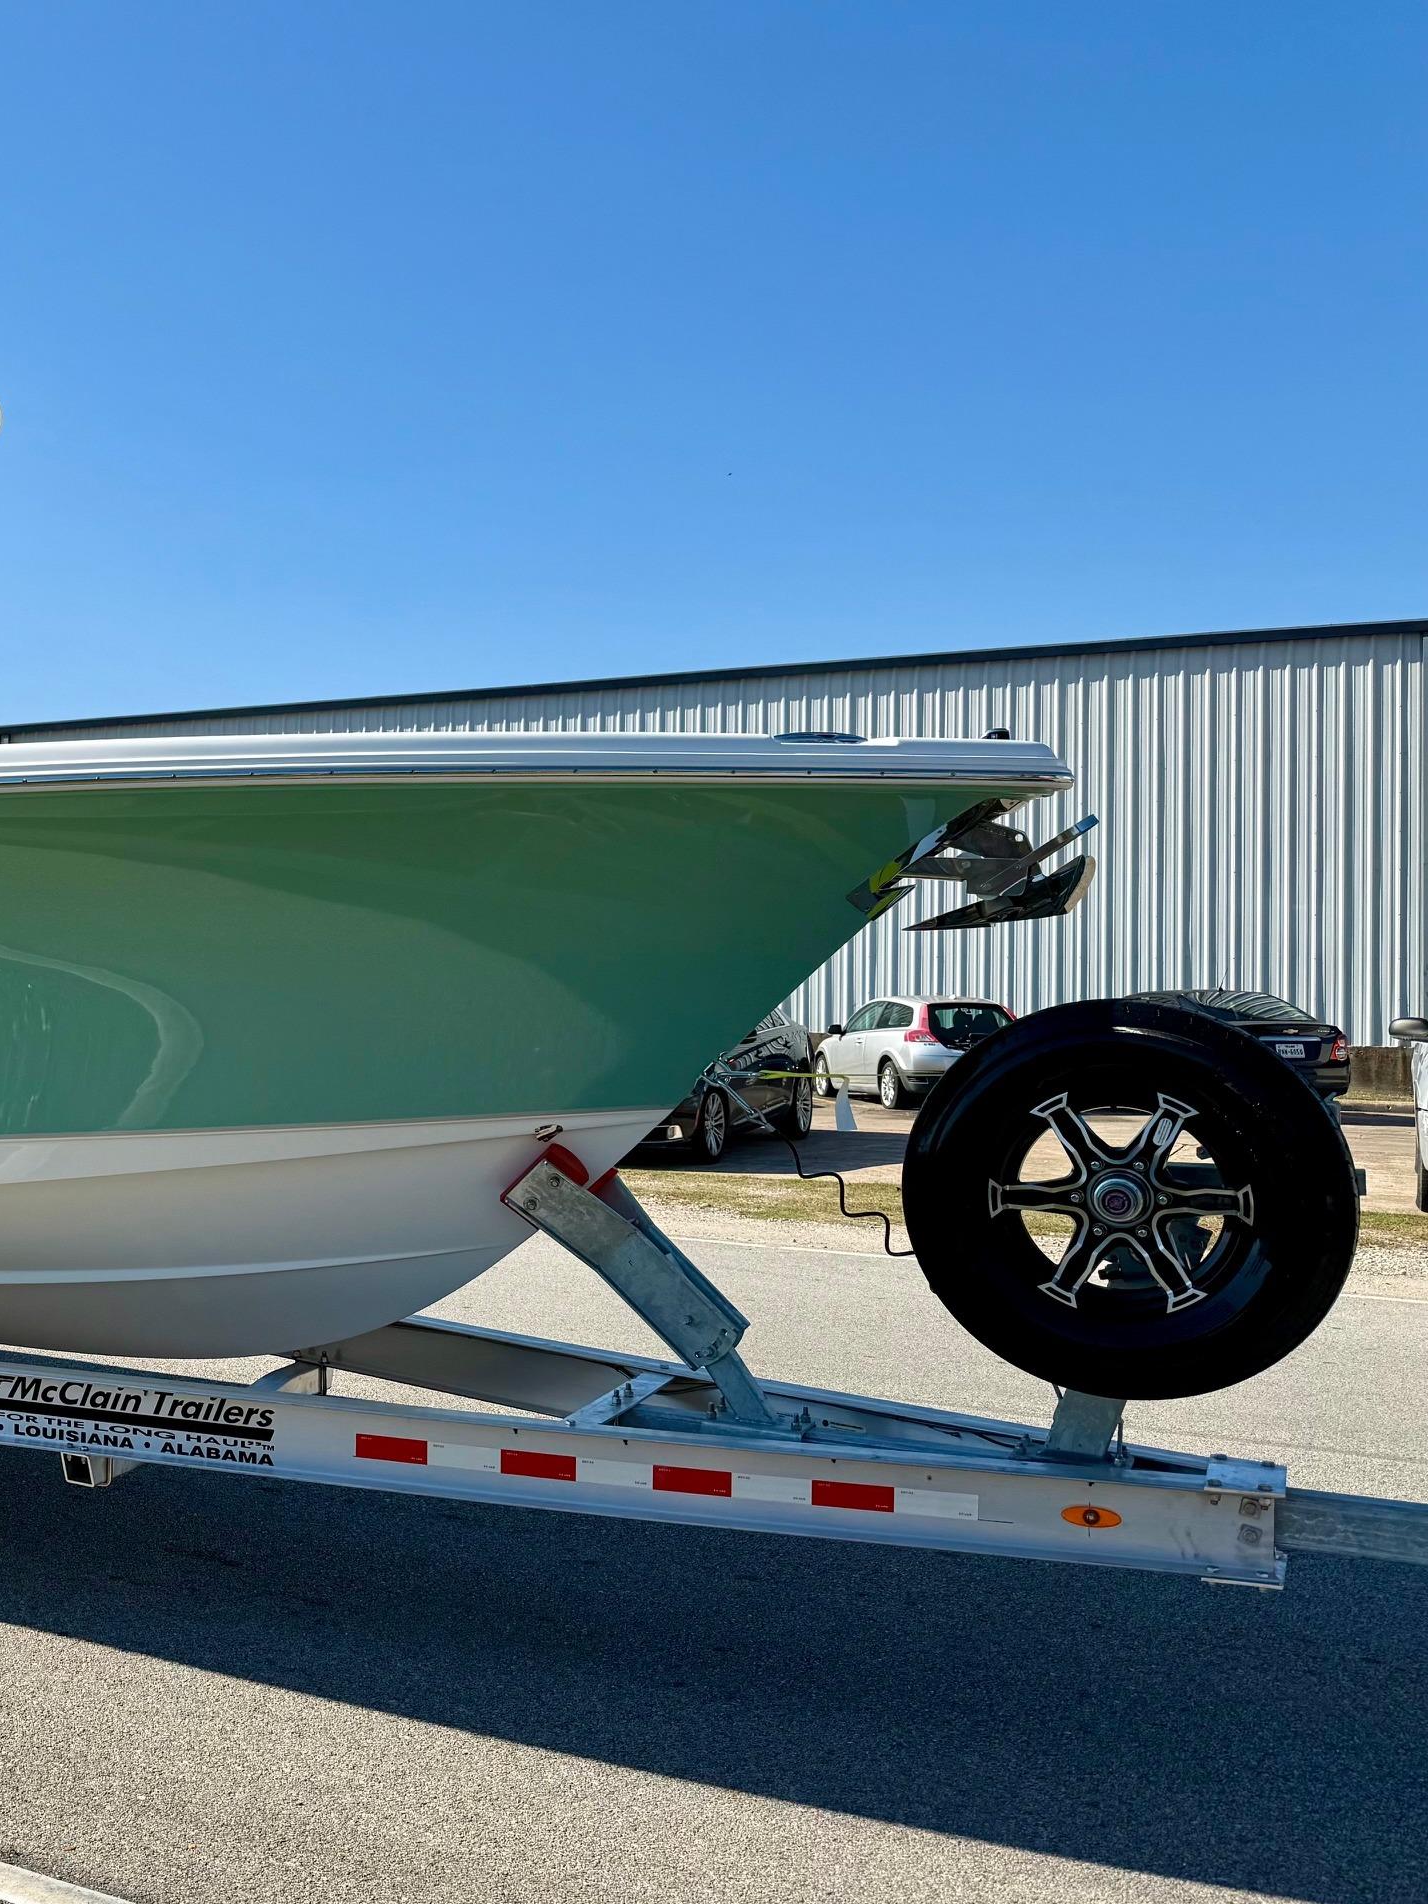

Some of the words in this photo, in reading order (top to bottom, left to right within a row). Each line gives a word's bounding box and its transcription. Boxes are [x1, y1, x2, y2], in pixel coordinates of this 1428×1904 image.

[7, 1376, 142, 1413] McClain
[152, 1391, 275, 1428] Trailers
[14, 1424, 134, 1449] LOUISIANA
[161, 1442, 275, 1467] ALABAMA
[44, 1417, 84, 1429] THE
[94, 1423, 176, 1440] LONG
